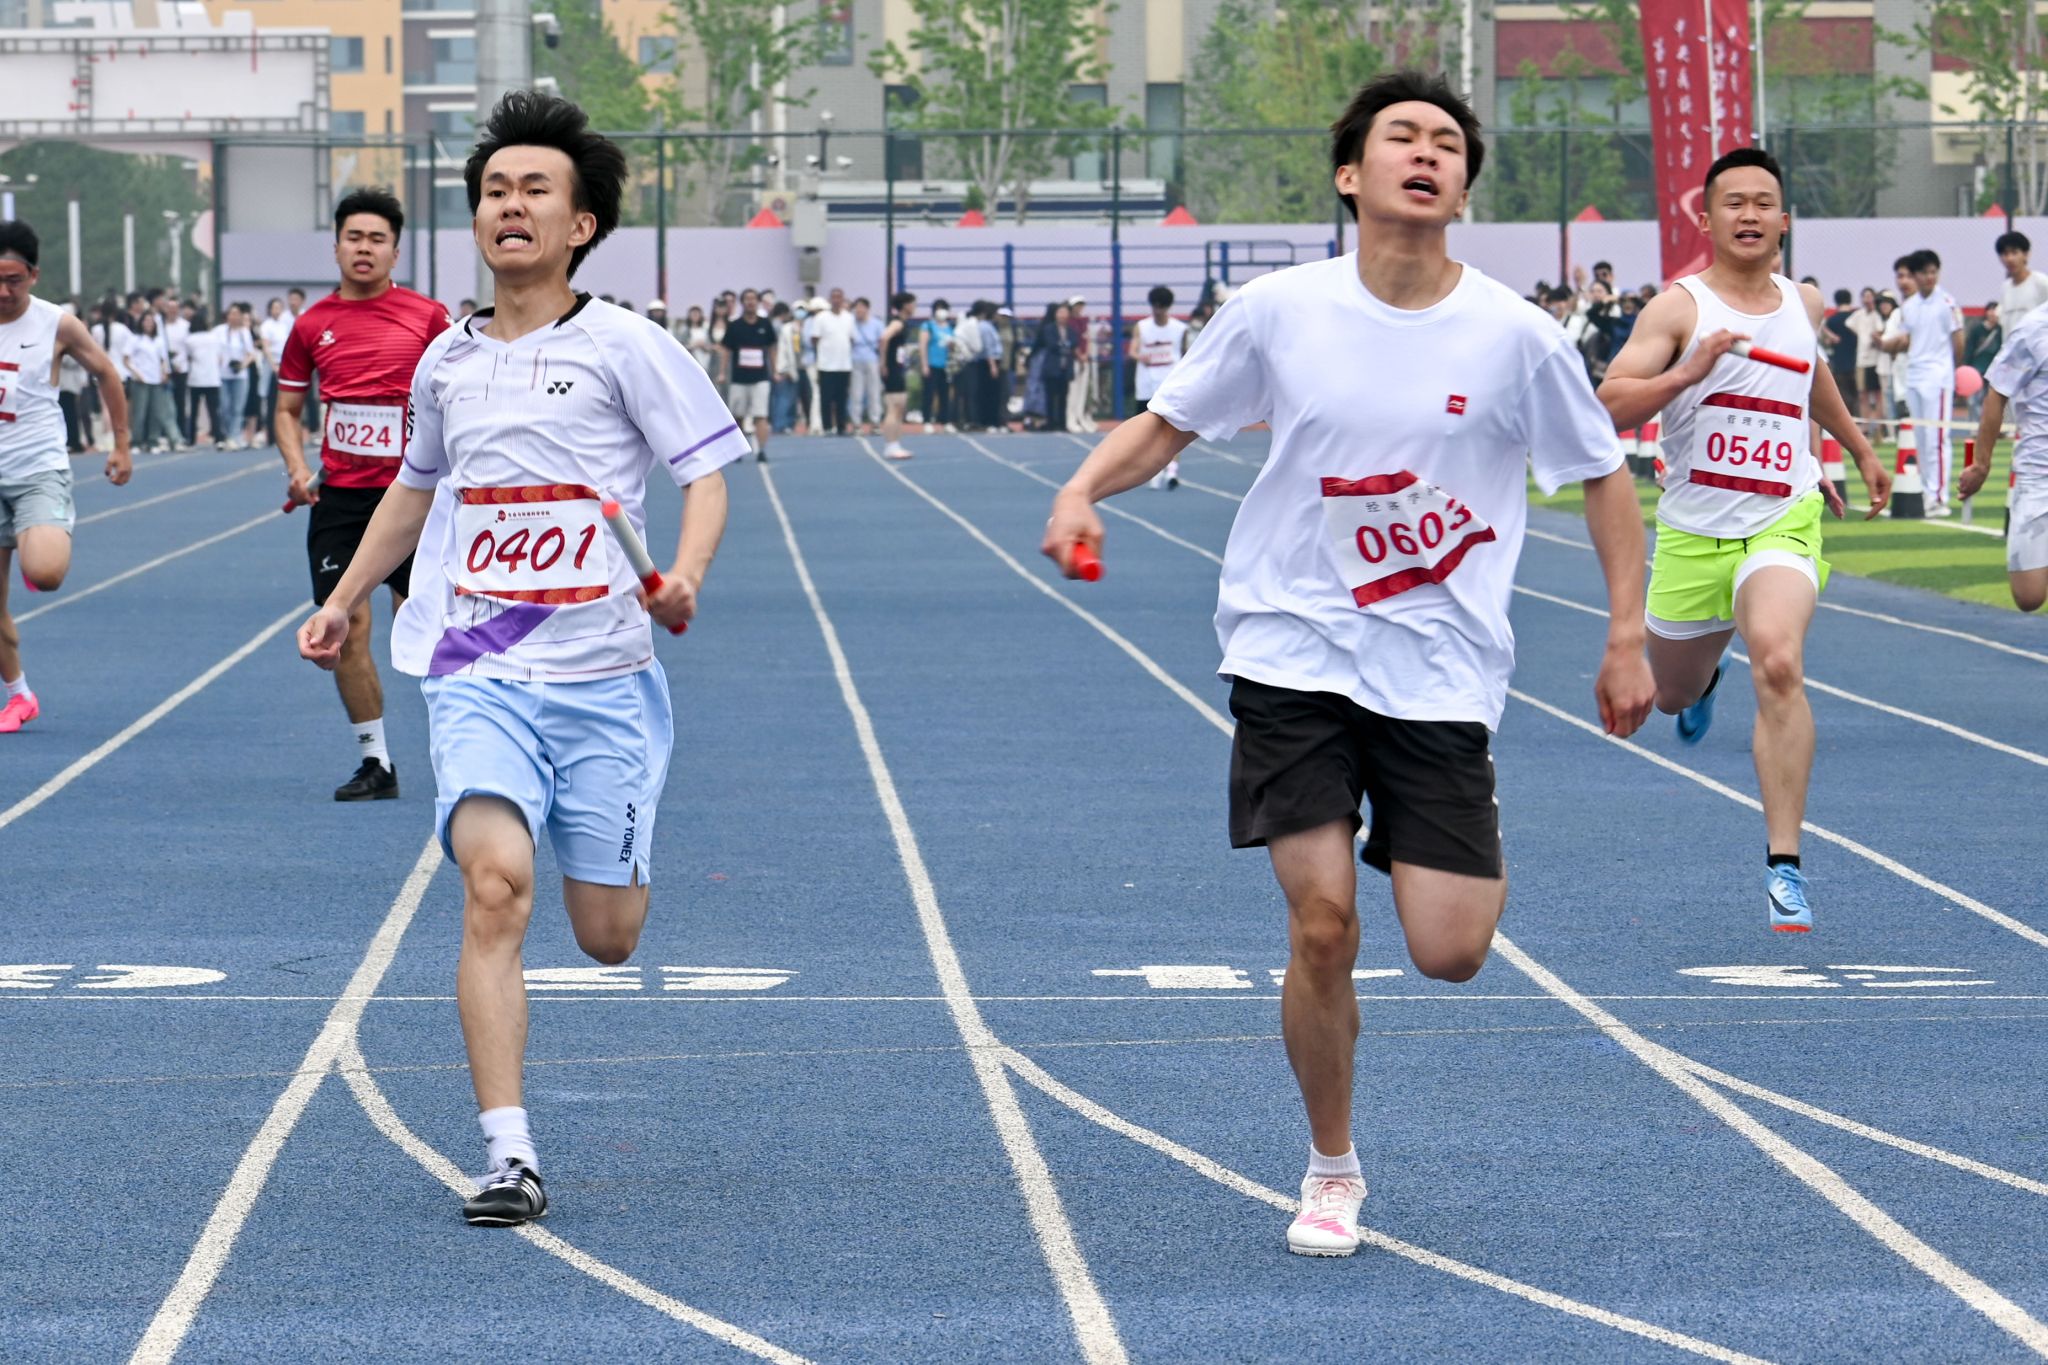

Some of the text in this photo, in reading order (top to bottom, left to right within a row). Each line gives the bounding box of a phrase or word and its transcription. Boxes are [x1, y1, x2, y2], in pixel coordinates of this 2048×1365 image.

[334, 421, 392, 448] 0224
[1727, 414, 1782, 430] 管理学院
[1706, 431, 1793, 472] 0549
[466, 523, 597, 574] 0401
[1355, 498, 1473, 564] 0603
[618, 824, 636, 864] YONEX
